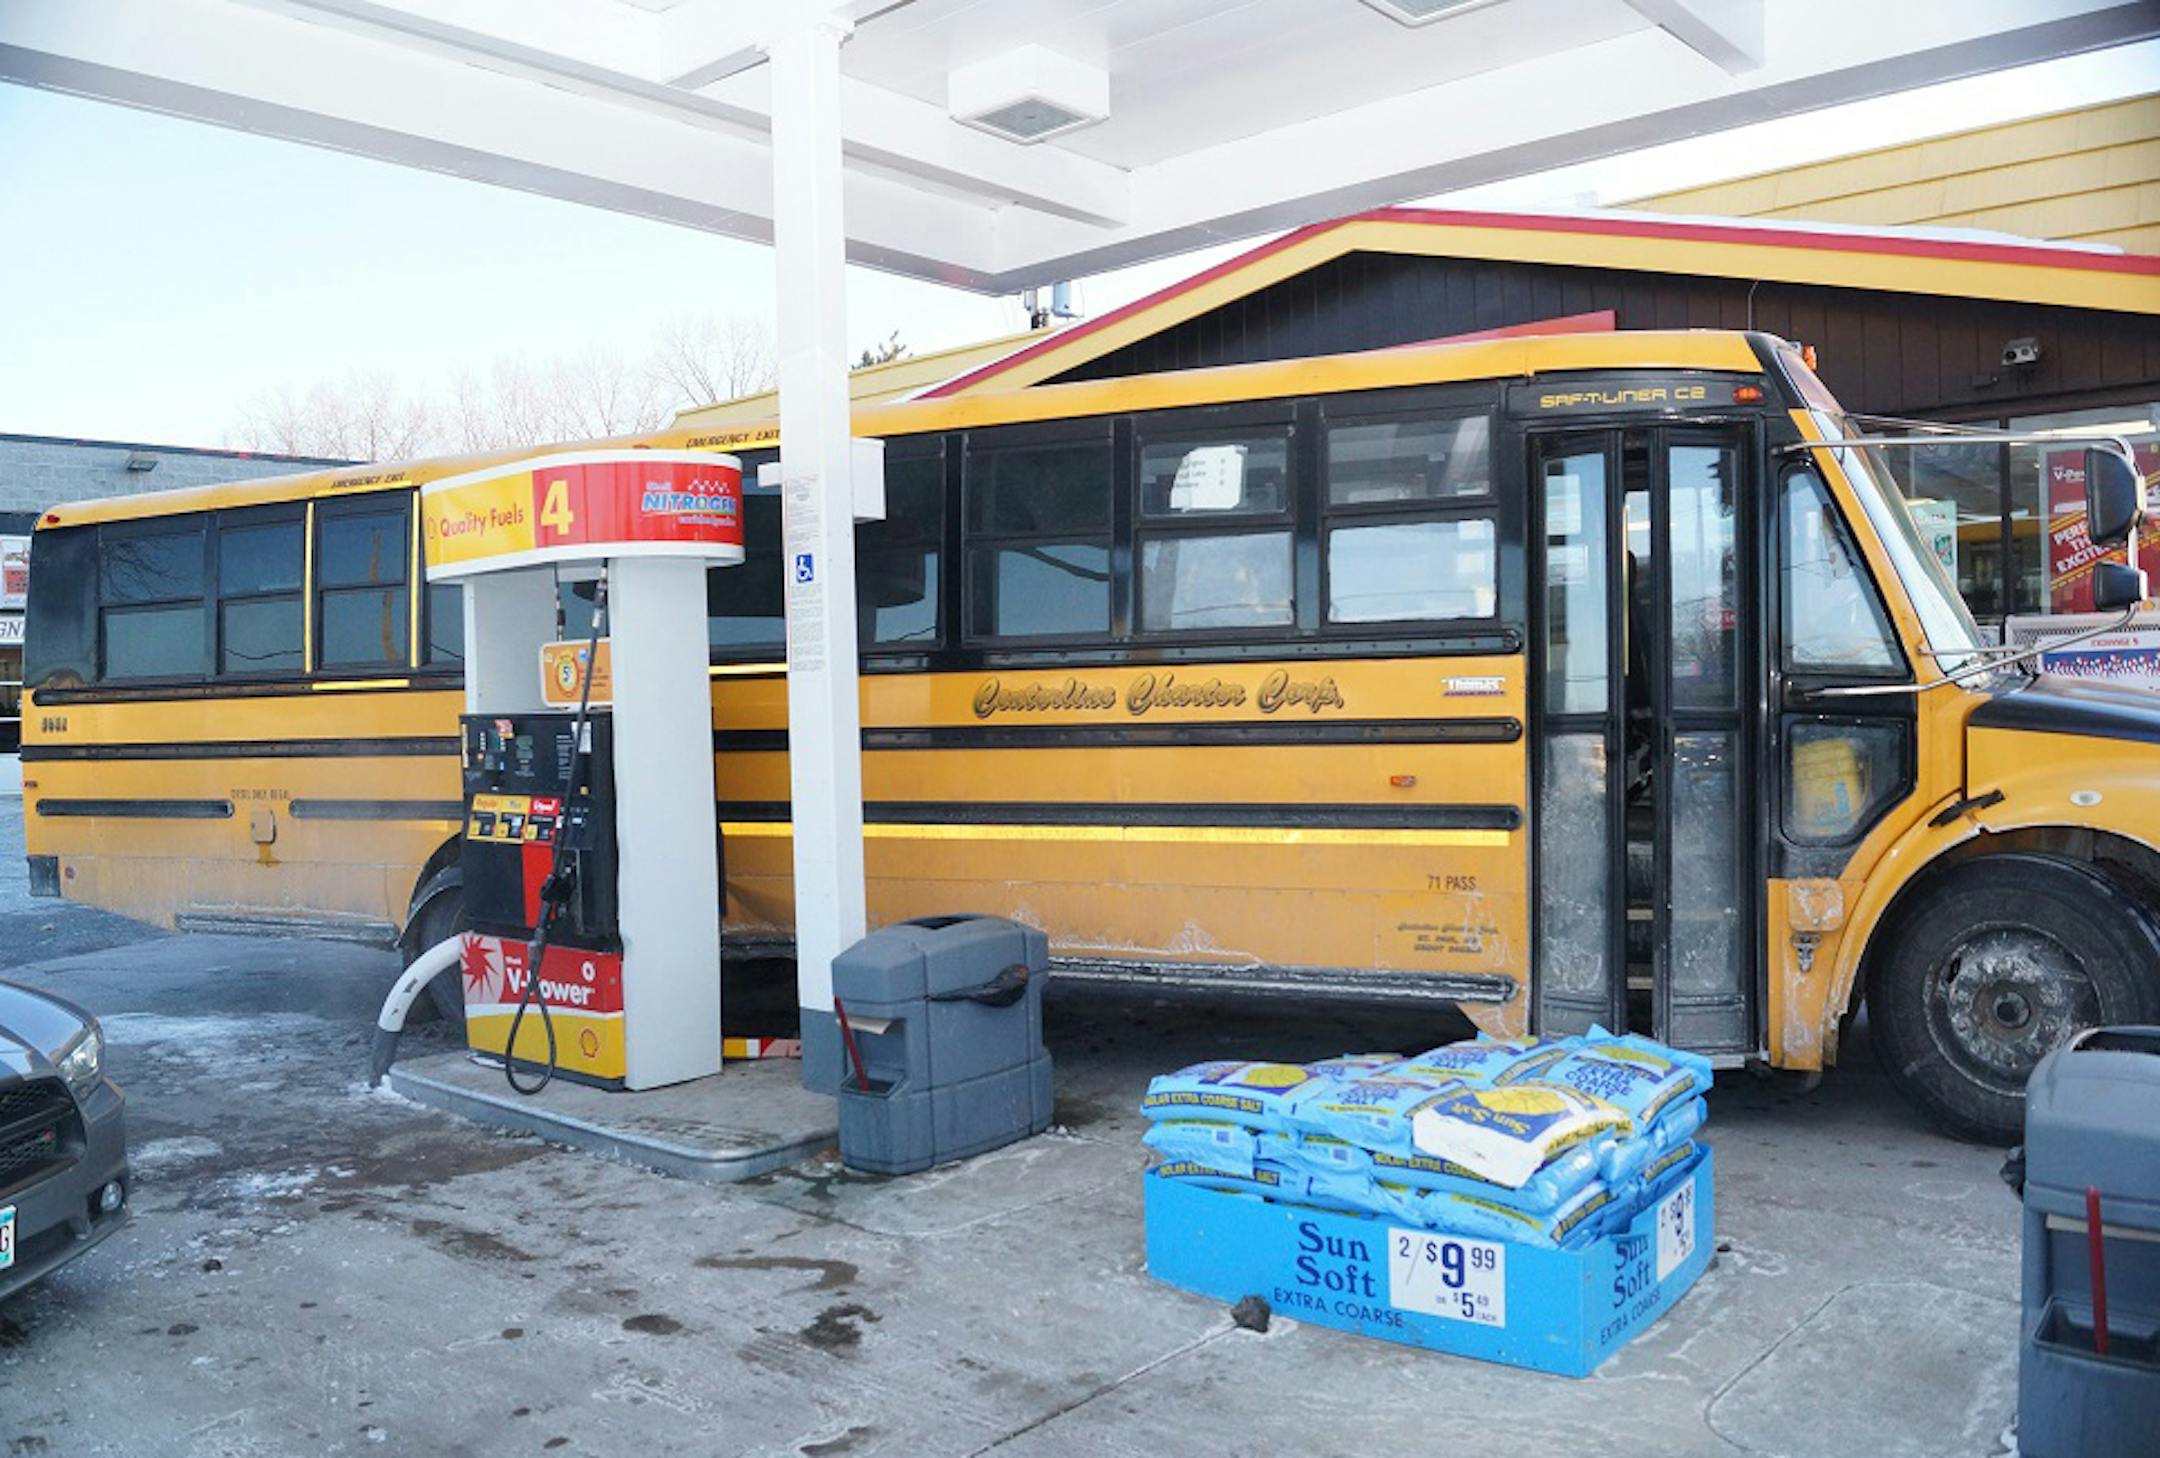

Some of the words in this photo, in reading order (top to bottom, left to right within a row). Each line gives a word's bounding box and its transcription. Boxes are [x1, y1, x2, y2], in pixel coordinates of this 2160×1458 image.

[1539, 387, 1667, 409] SAF-T-LINER
[1675, 386, 1706, 399] C2
[686, 433, 749, 448] EMERGENCY
[755, 429, 780, 441] EXIT
[440, 511, 487, 537] Quality
[489, 502, 525, 529] Fuels
[540, 480, 574, 536] 4
[974, 676, 1116, 719] Centerline
[1126, 672, 1246, 716] Charter
[1428, 874, 1441, 890] 71
[1446, 875, 1476, 891] PASS
[1171, 1093, 1199, 1104] EXTRA
[1201, 1095, 1238, 1110] COARSE
[1240, 1099, 1263, 1113] SALT
[1298, 1221, 1371, 1263] Sun
[1615, 1233, 1649, 1270] Sun
[1296, 1256, 1376, 1298] Soft
[1613, 1259, 1652, 1309] Soft
[1274, 1287, 1328, 1313] EXTRA
[1334, 1300, 1404, 1328] COARSE
[1600, 1312, 1629, 1345] EXTRA
[1631, 1285, 1662, 1323] COARSE
